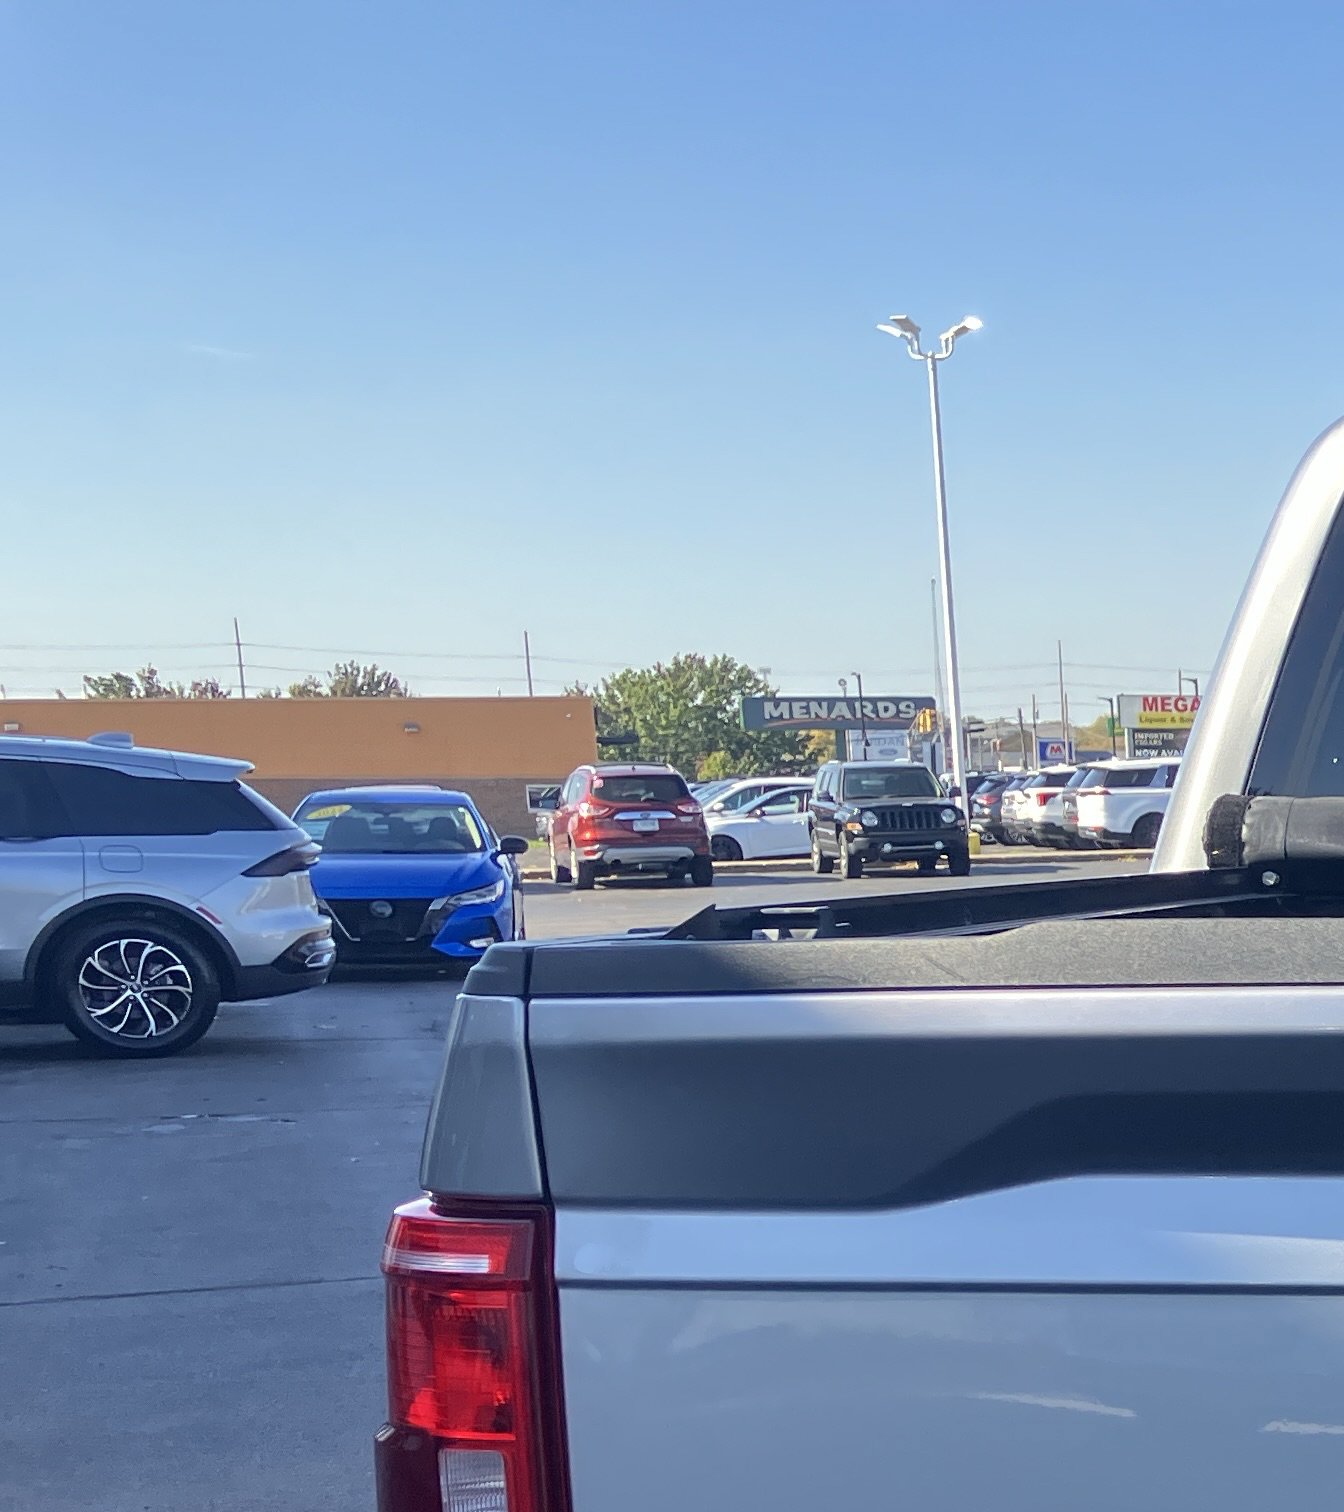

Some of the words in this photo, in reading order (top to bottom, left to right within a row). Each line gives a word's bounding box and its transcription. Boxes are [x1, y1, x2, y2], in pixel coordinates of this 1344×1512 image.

[763, 701, 917, 721] MENARDS
[1142, 696, 1201, 712] MEGA
[1135, 749, 1159, 757] NOW
